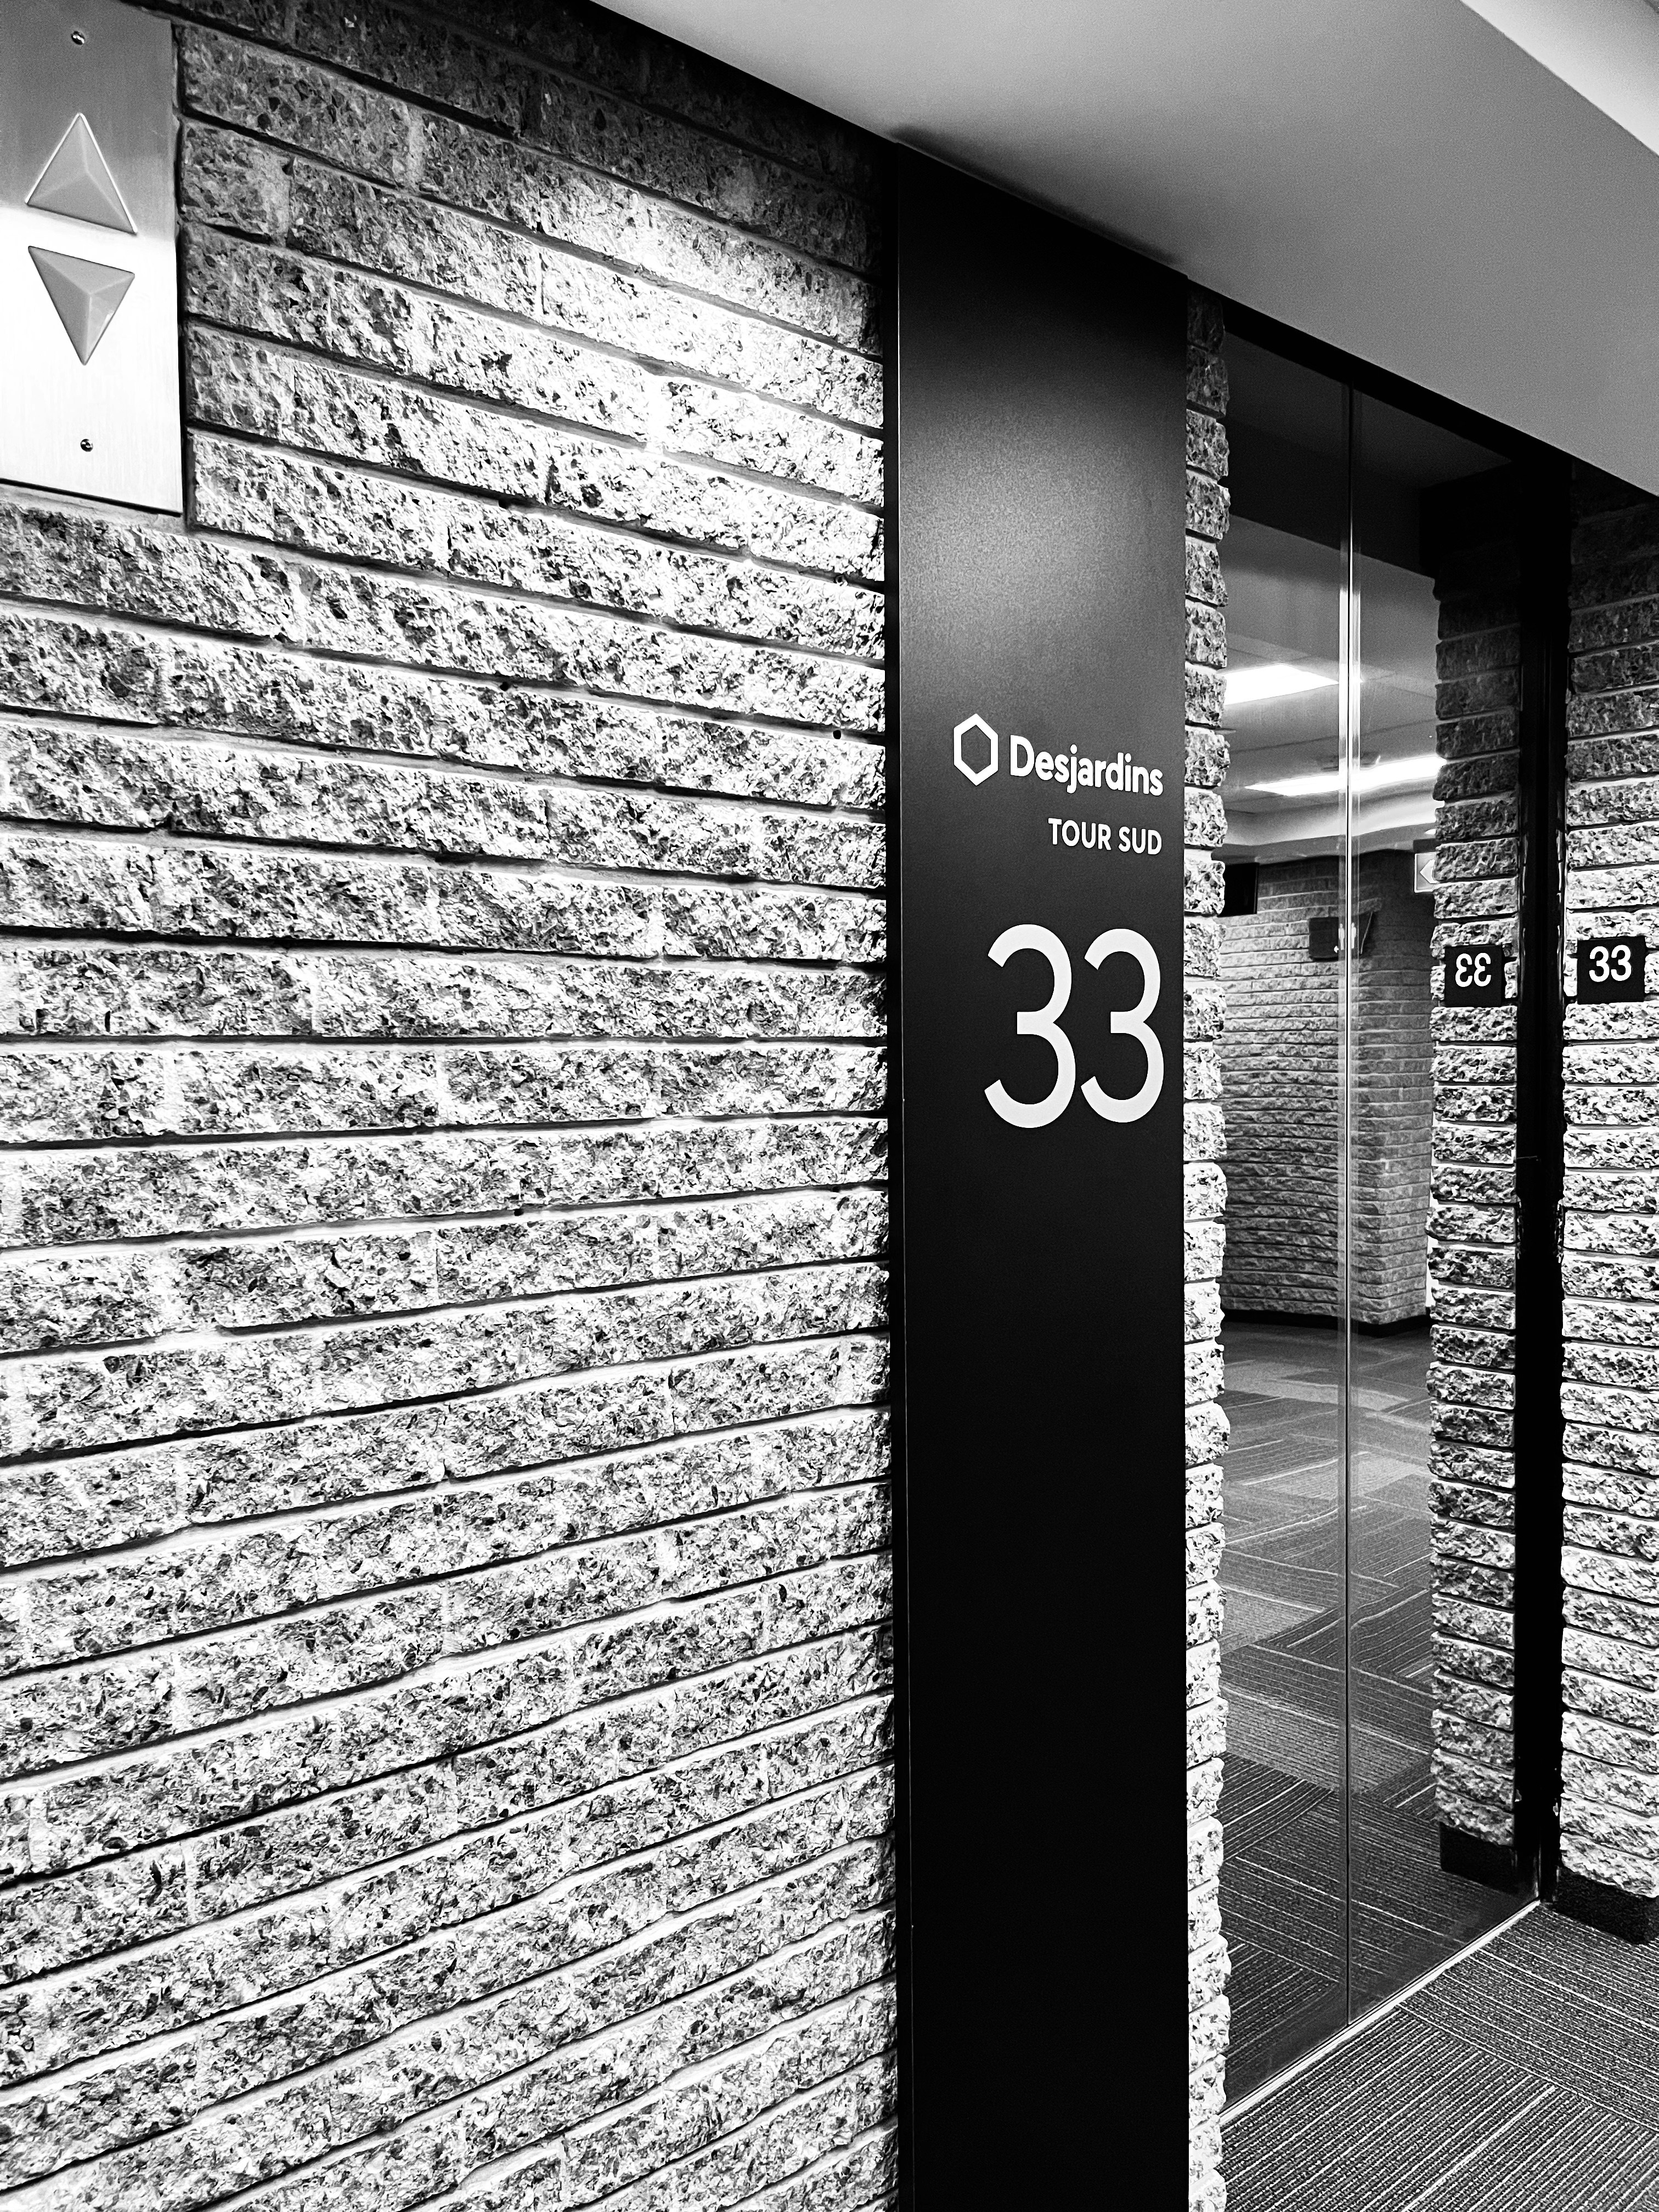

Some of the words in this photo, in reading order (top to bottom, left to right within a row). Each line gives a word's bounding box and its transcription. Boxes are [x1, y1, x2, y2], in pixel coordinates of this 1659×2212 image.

[1009, 734, 1164, 797] Desjardins
[1047, 817, 1112, 851] TOUR
[1118, 825, 1163, 855] SUD
[1588, 944, 1632, 983] 33
[984, 923, 1165, 1129] 33
